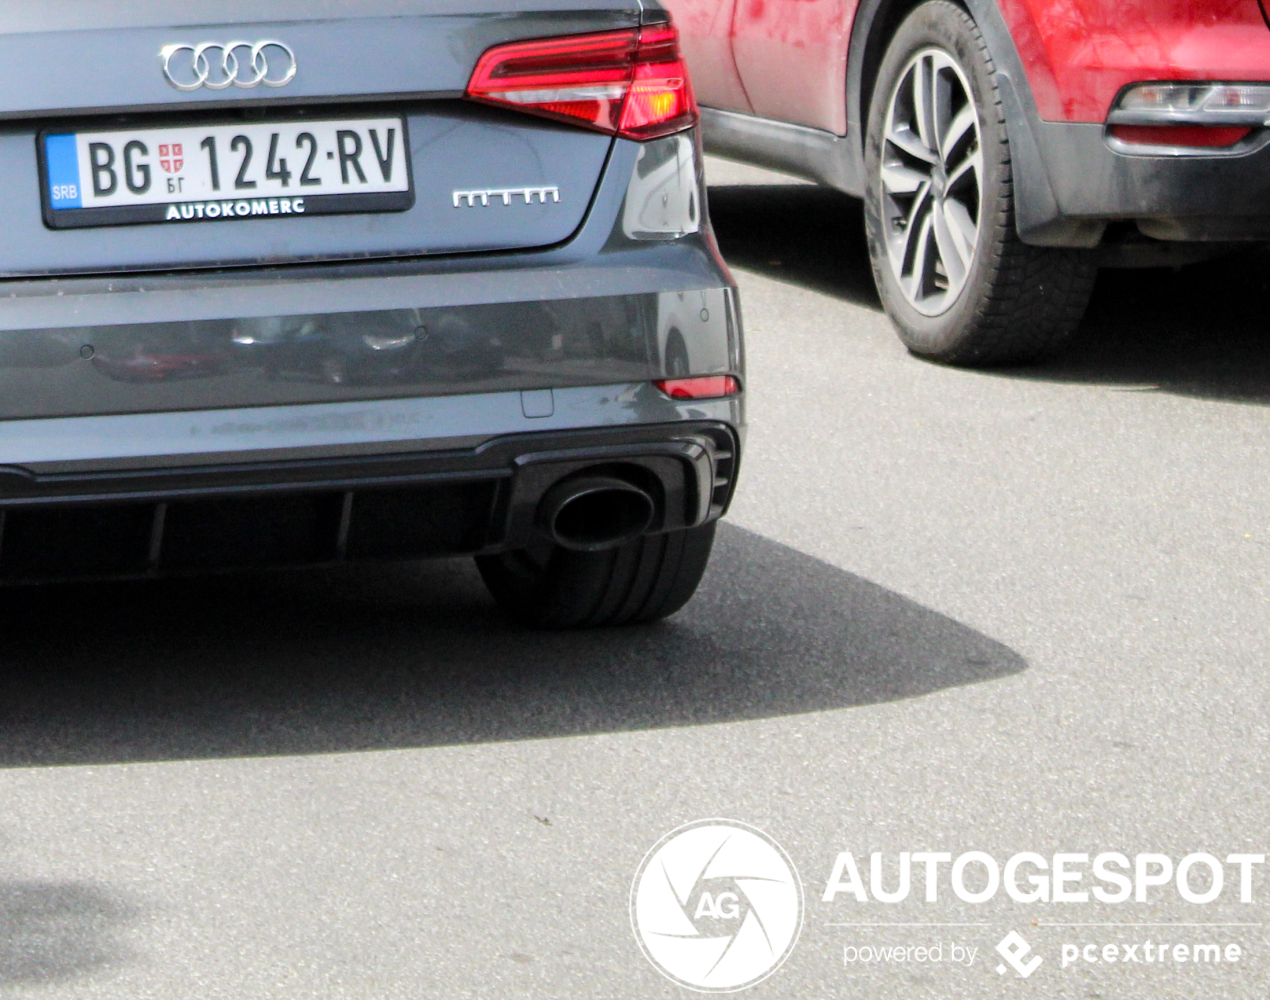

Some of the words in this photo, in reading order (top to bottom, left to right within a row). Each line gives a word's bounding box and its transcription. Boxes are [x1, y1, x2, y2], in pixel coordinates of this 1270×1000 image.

[88, 139, 152, 198] BG
[52, 184, 78, 200] SRB
[165, 198, 305, 221] AUTOKOMERC
